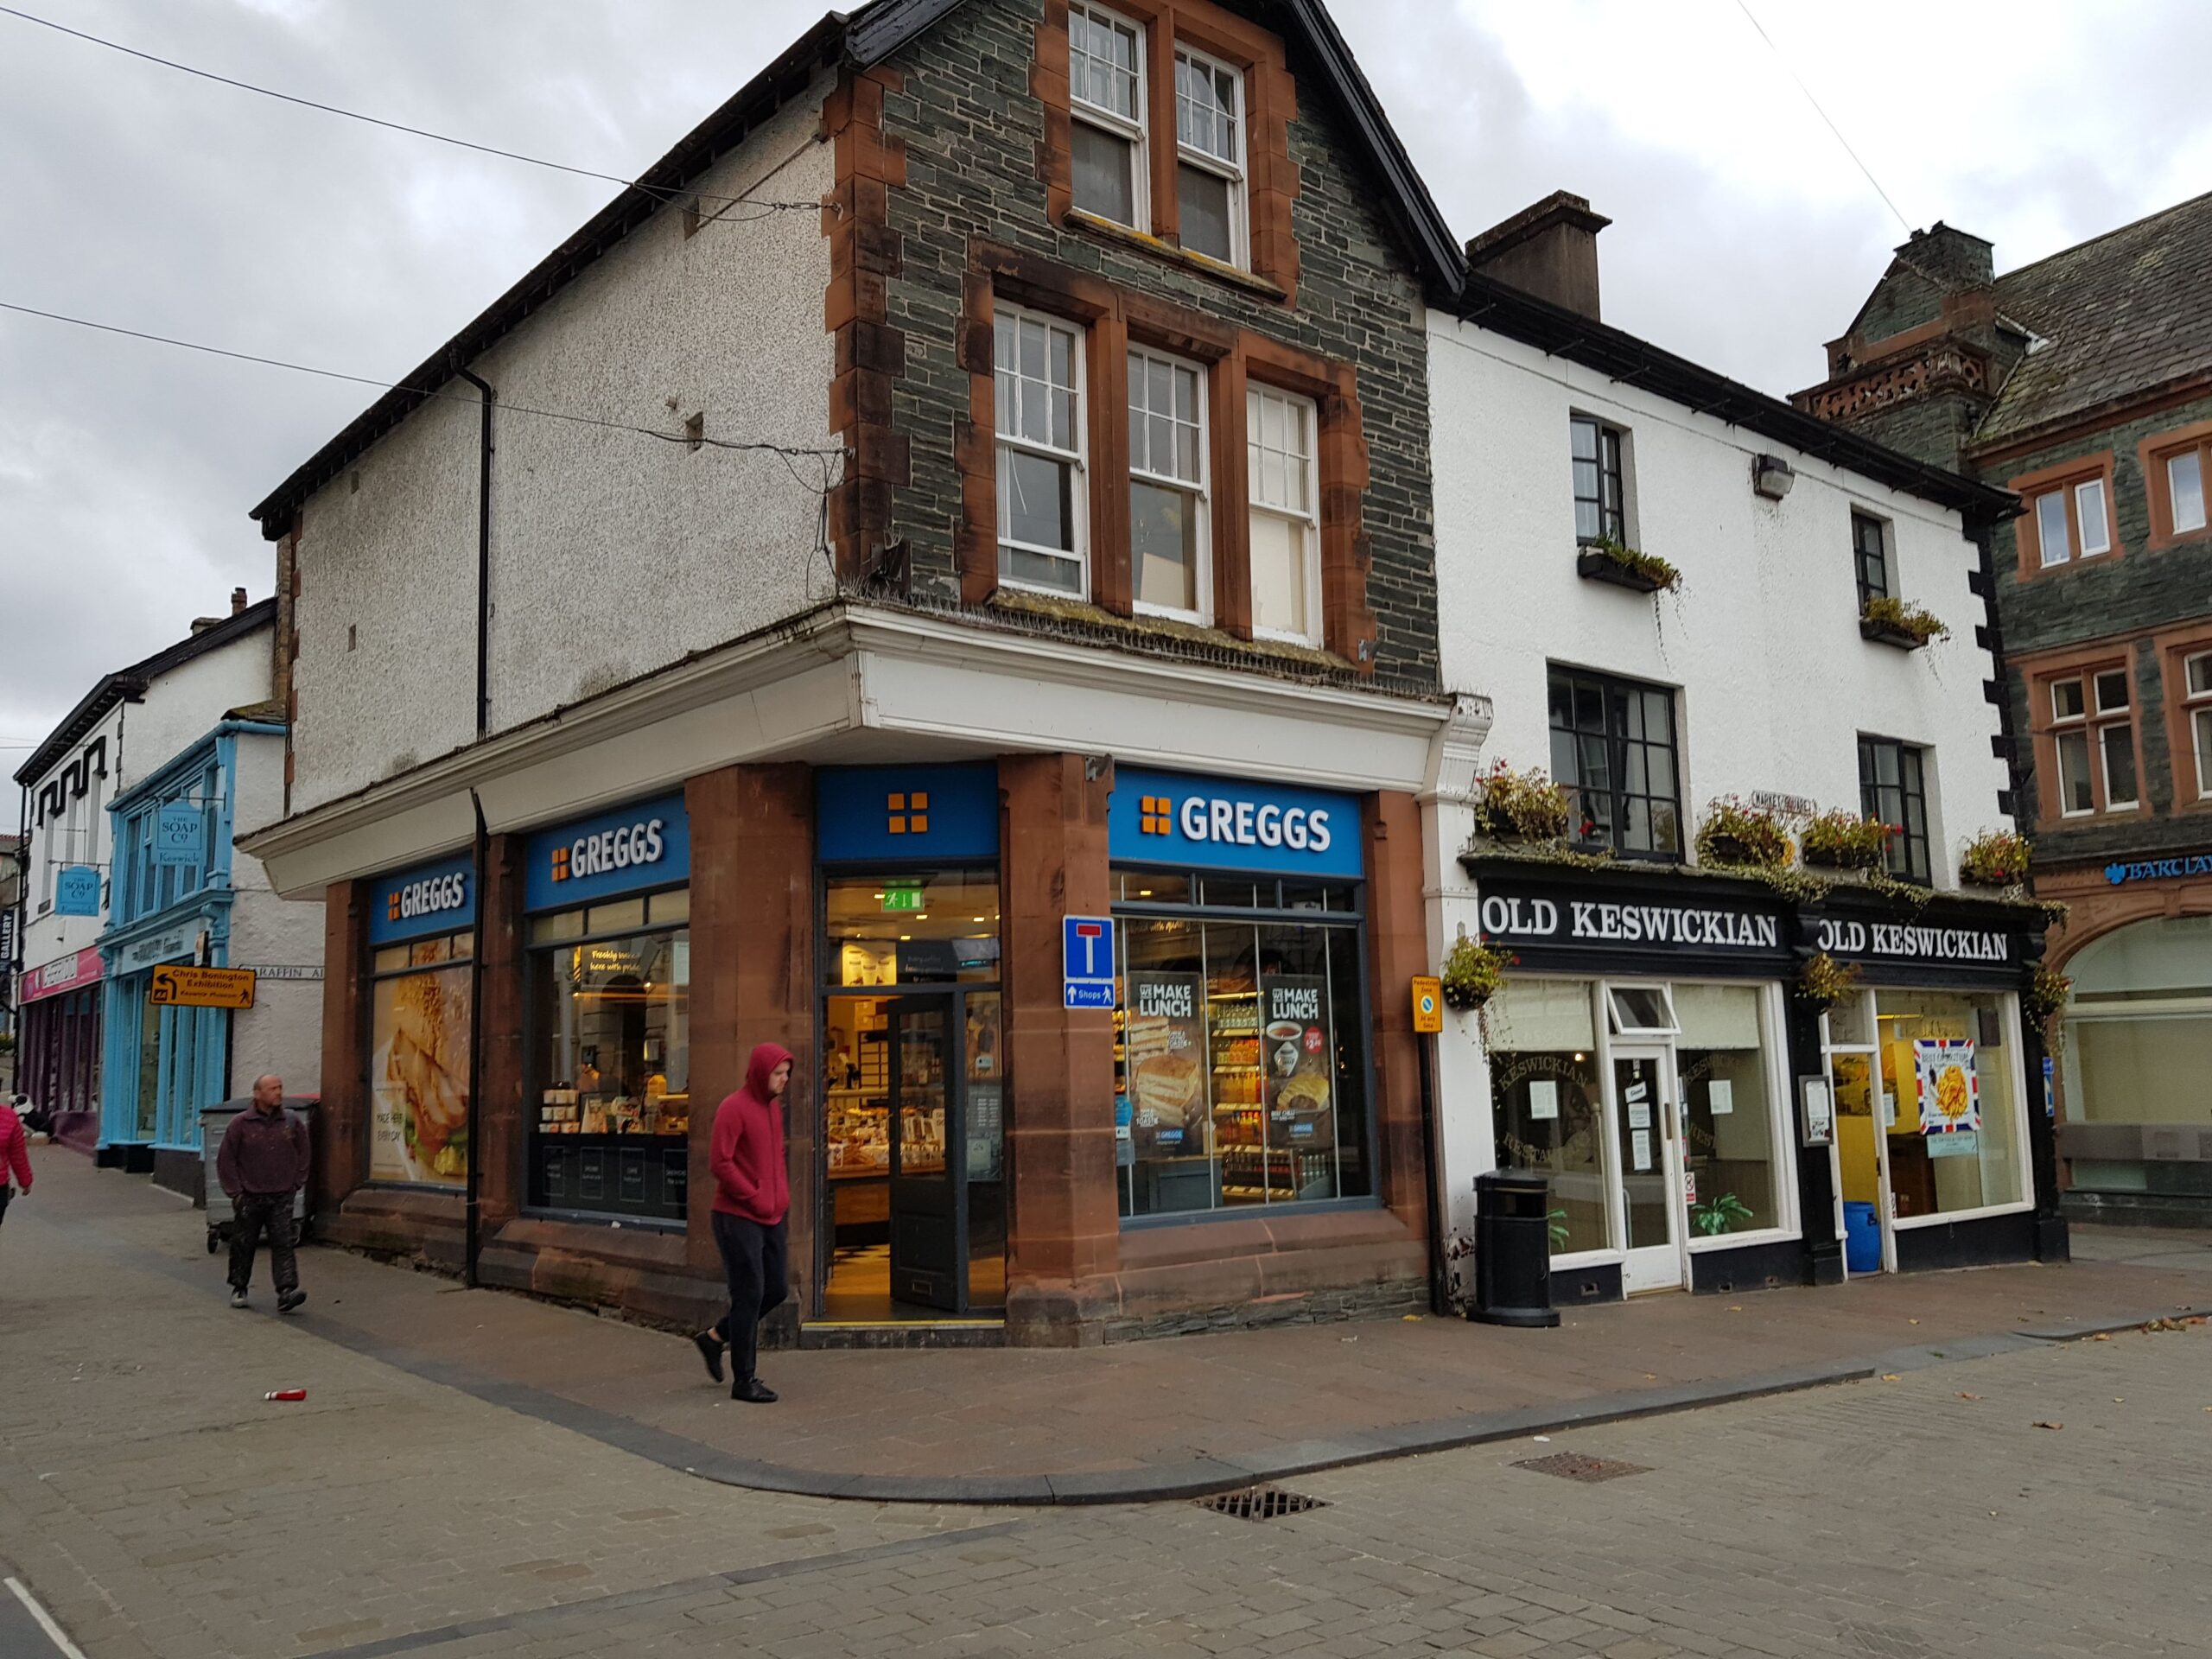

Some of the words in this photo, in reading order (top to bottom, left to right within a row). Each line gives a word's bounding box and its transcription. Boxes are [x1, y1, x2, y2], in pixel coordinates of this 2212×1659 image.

[162, 822, 198, 833] SOAP
[1180, 797, 1331, 852] GREGGS
[571, 818, 664, 878] GREGGS
[65, 882, 94, 892] SOAP
[401, 872, 464, 918] GREGGS
[1482, 896, 1557, 935] OLD
[1570, 902, 1777, 947] KESWICKIAN
[1, 914, 12, 959] GALLERY
[1817, 918, 1866, 951] OLD
[1871, 924, 2007, 961] KESWICKIAN
[173, 969, 198, 978] Chris
[201, 971, 250, 982] Bonington
[187, 979, 235, 988] Exhibition
[1078, 989, 1102, 1000] Shops
[1154, 984, 1192, 1000] MAKE
[1284, 988, 1319, 1003] MAKE
[1140, 999, 1192, 1017] LUNCH
[1273, 1002, 1319, 1019] LUNCH
[1498, 1056, 1588, 1092] KESWICKIAN
